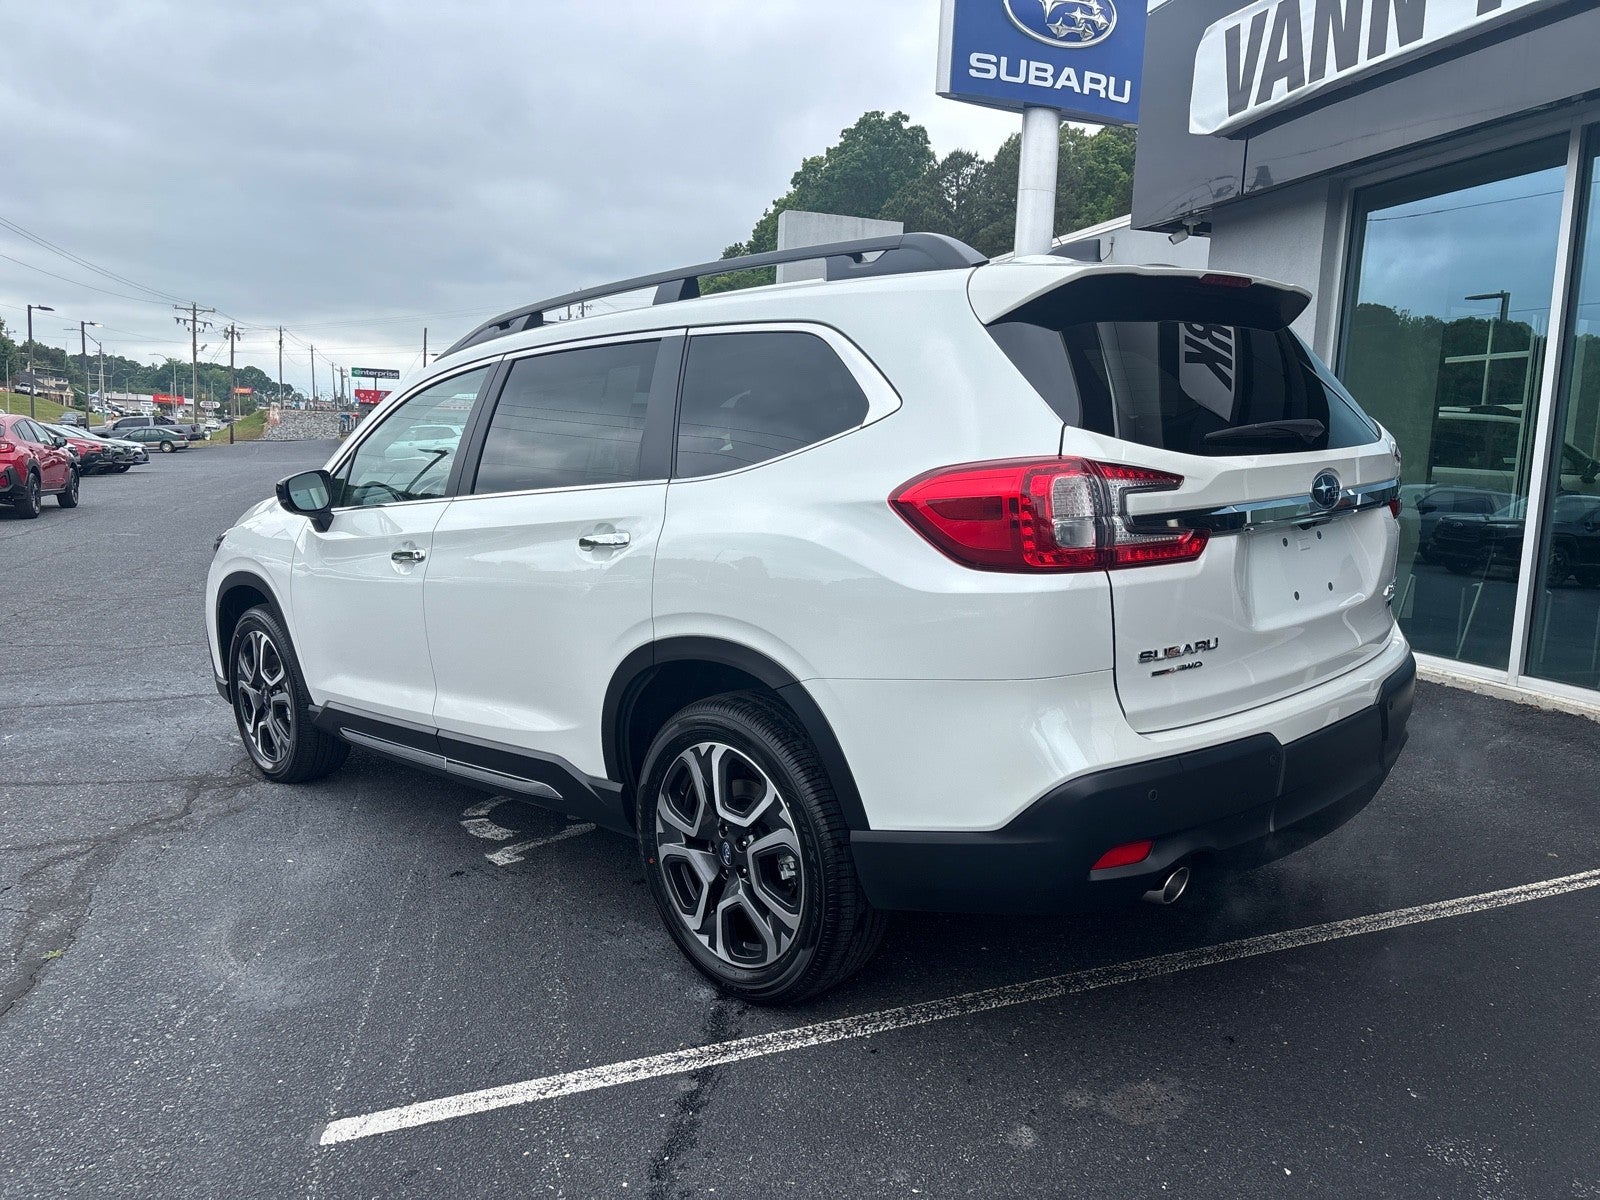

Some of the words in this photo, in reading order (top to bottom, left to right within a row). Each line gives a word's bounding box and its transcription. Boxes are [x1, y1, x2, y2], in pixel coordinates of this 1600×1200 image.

[968, 52, 1132, 104] SUBARU
[1224, 0, 1427, 118] VANN
[353, 369, 399, 377] enterprise
[1138, 637, 1219, 664] SUBARU
